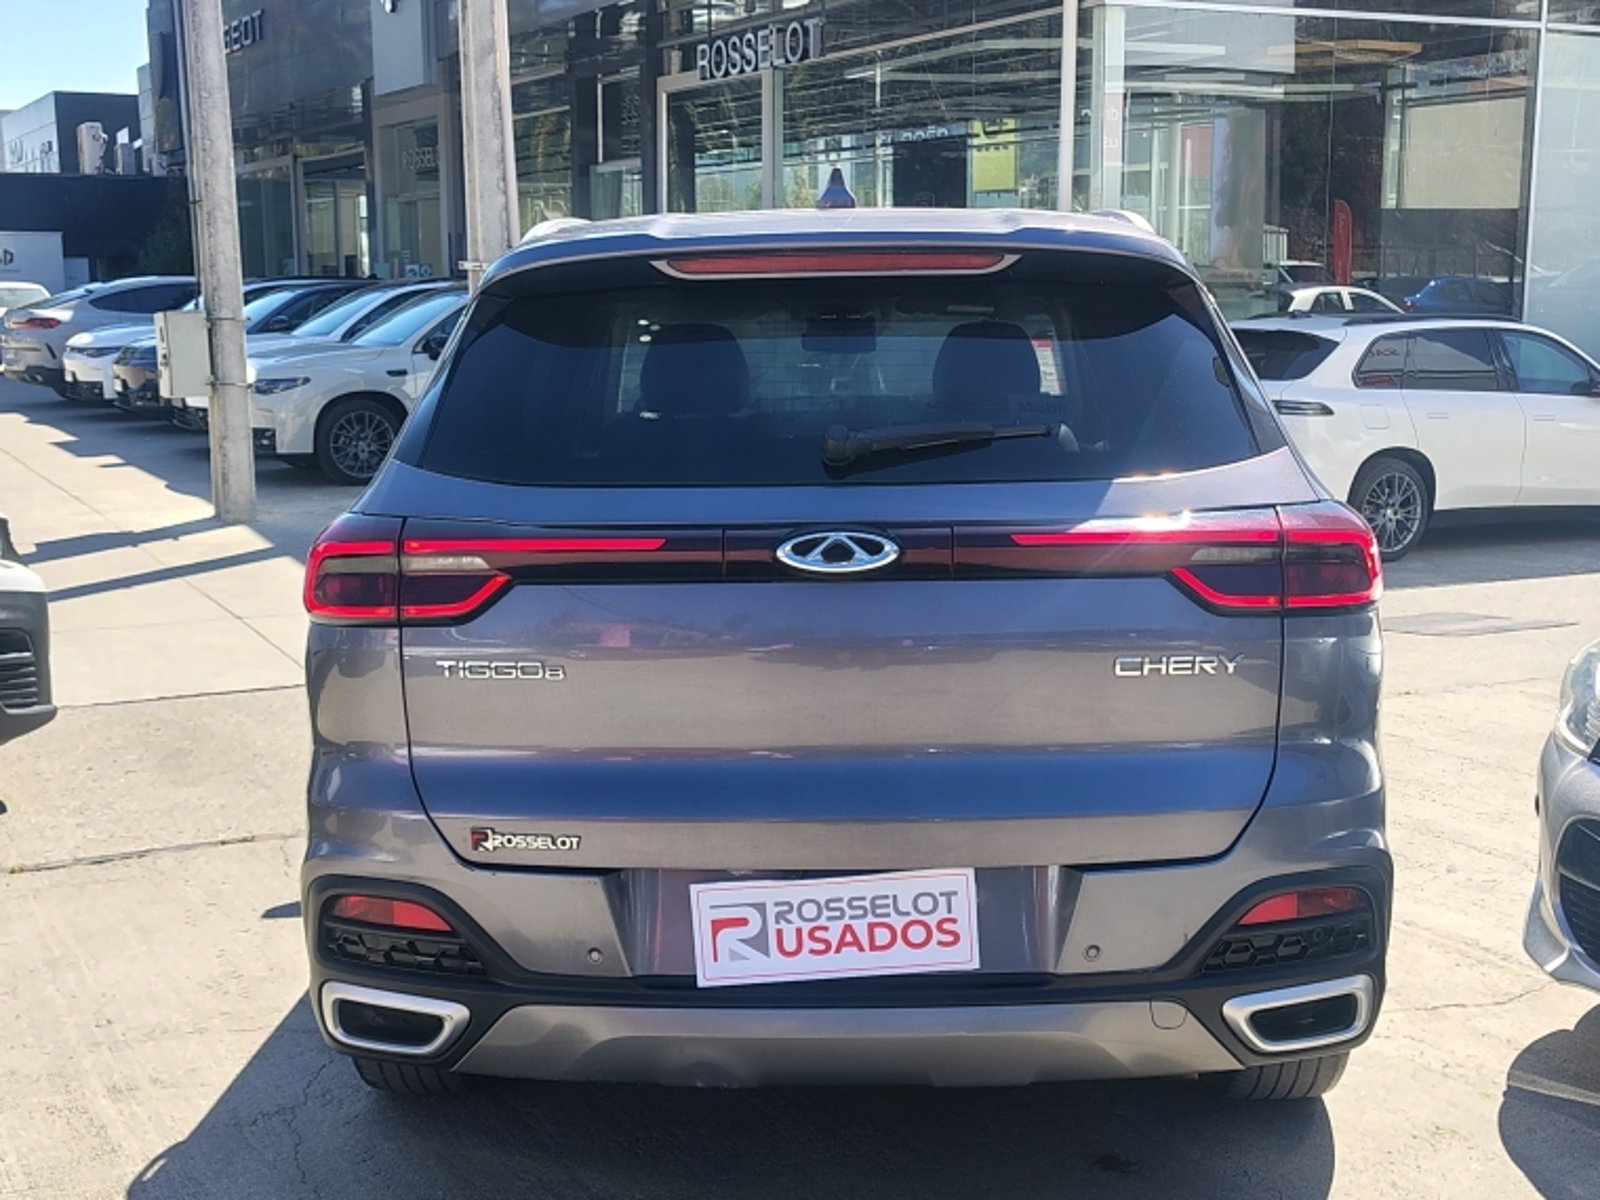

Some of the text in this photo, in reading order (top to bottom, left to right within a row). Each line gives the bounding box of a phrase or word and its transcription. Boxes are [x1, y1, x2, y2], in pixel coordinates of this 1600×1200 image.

[696, 17, 824, 80] ROSSELOT
[1114, 654, 1245, 677] CHERY
[493, 834, 581, 850] ROSSELOT
[774, 890, 958, 925] ROSSELOT
[775, 917, 961, 958] USADOS
